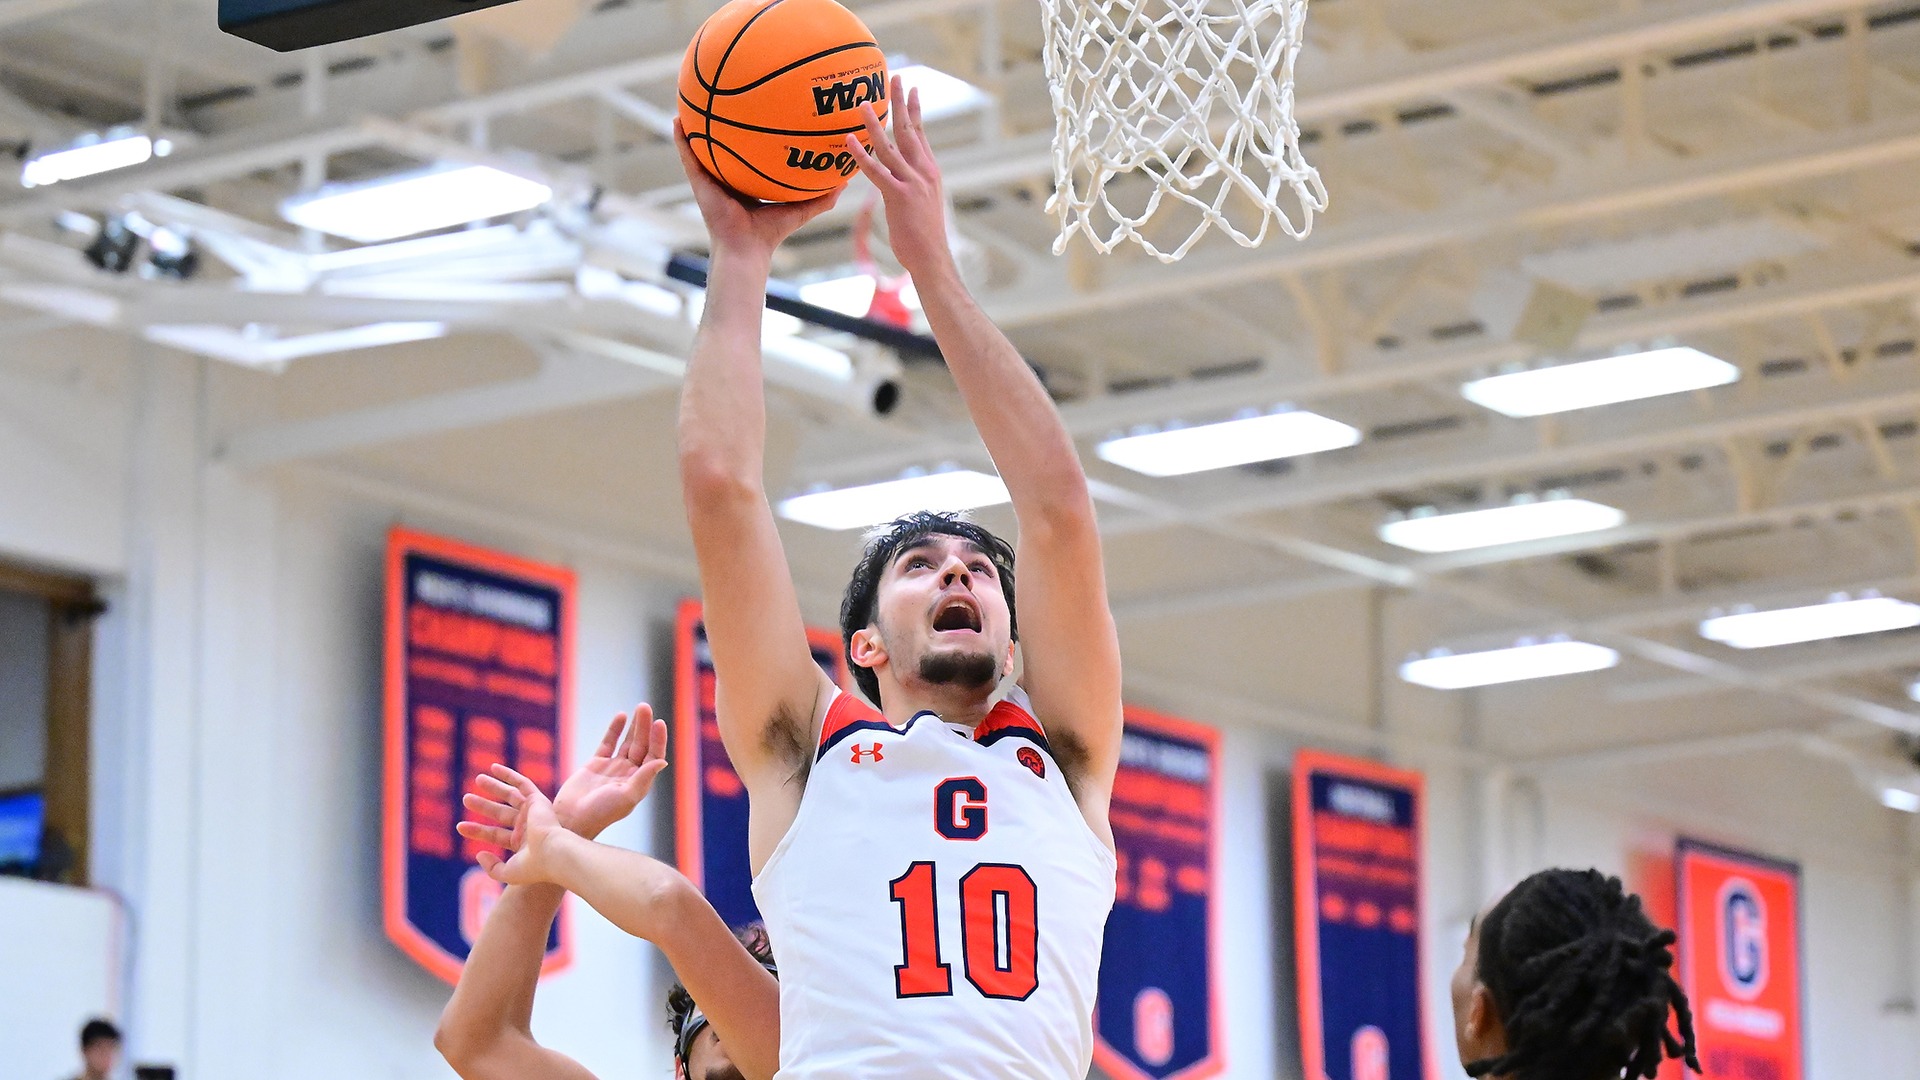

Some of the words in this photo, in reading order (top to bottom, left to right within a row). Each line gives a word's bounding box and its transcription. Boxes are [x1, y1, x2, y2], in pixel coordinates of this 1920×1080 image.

[812, 70, 885, 116] NCAA
[786, 144, 874, 177] lson
[934, 776, 988, 841] G
[889, 861, 1039, 1002] 10
